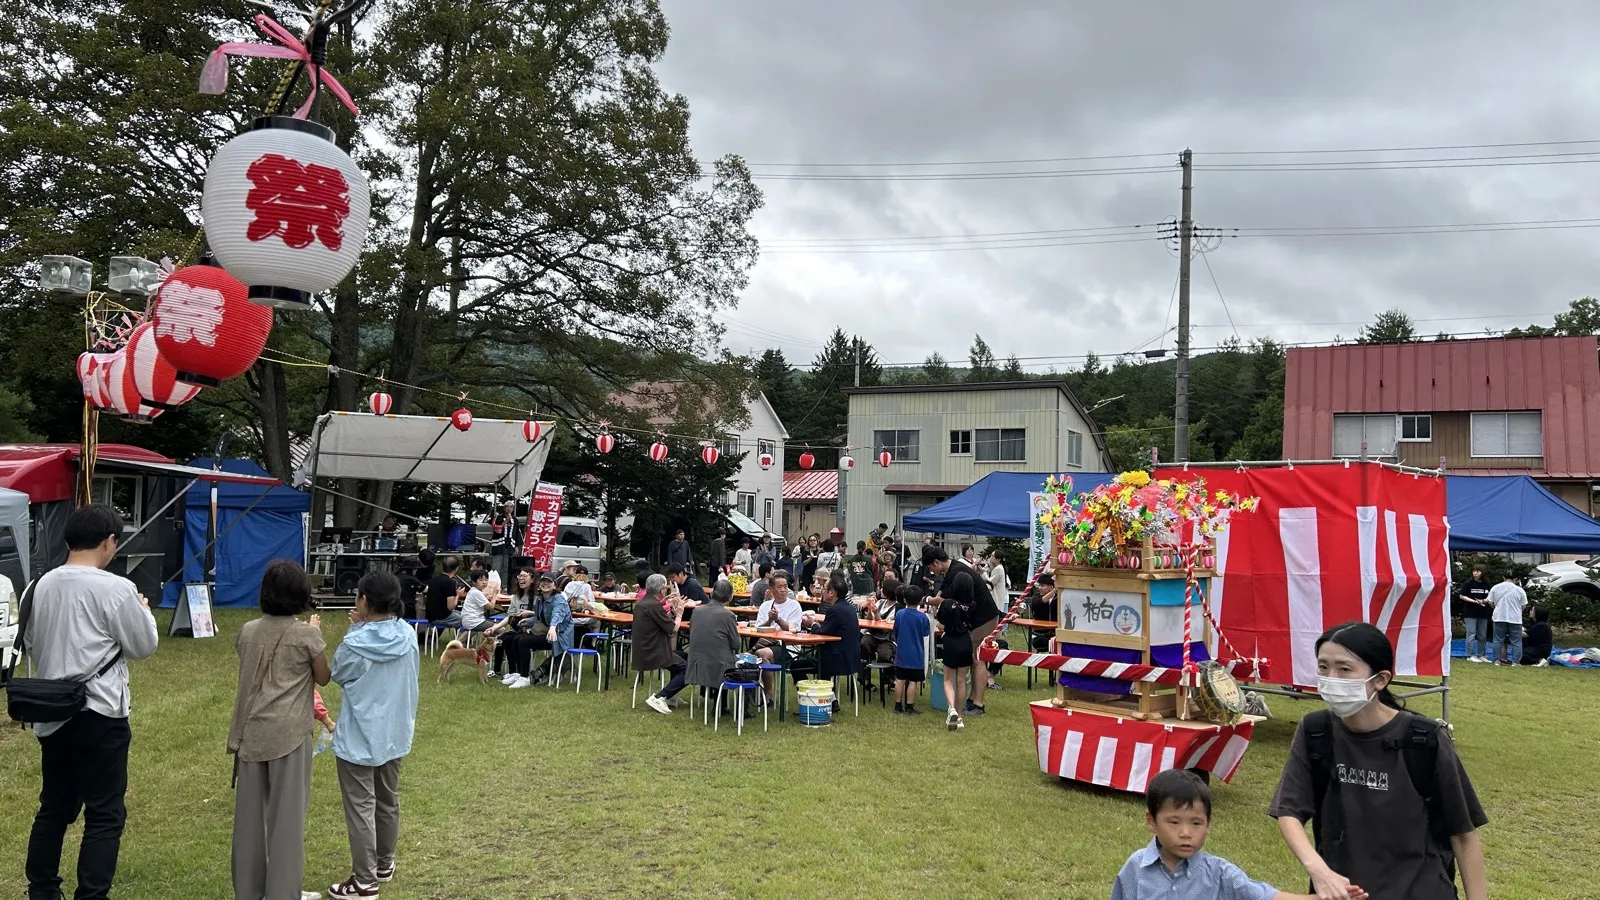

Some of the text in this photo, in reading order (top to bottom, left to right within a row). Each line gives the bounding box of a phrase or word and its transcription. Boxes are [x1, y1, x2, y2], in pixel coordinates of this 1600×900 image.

[246, 153, 350, 251] 祭
[155, 280, 225, 347] 祭
[530, 509, 547, 545] 歌おう
[542, 500, 560, 544] カラオケ
[1082, 596, 1115, 623] 柏台
